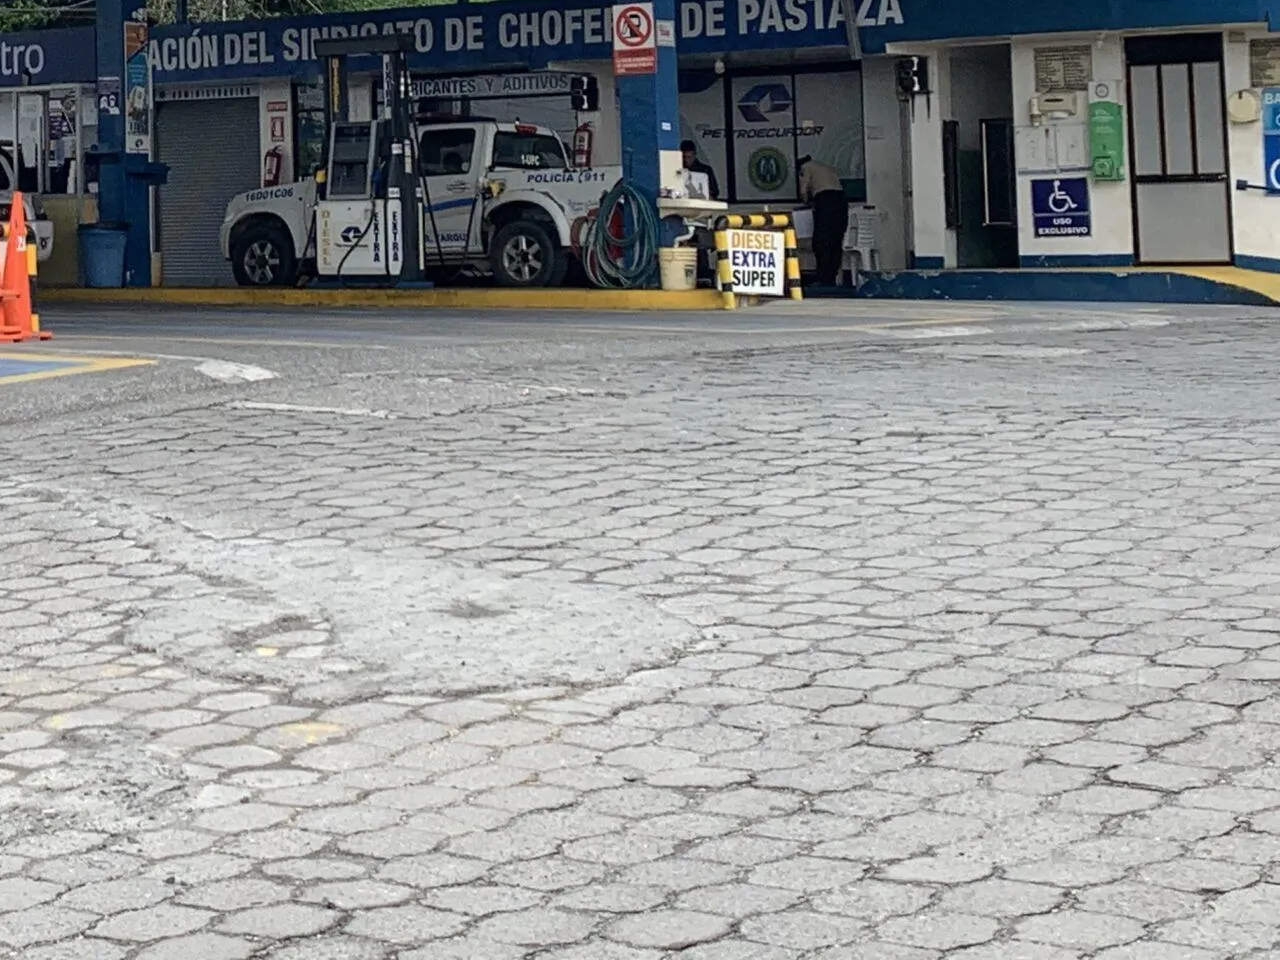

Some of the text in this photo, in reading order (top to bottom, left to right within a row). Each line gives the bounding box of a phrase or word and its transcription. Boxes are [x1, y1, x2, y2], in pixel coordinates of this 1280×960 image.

[224, 31, 275, 66] DEL
[444, 16, 485, 52] DE
[681, 0, 726, 38] DE
[485, 78, 494, 90] Y
[503, 74, 569, 91] ADITIVOS
[584, 172, 606, 182] 911
[1053, 217, 1073, 225] USO
[373, 212, 381, 262] EXTRA
[392, 211, 400, 262] EXTRA
[1038, 226, 1089, 235] EXCLUSIVO
[731, 231, 778, 250] DIESEL
[732, 250, 776, 268] EXTRA
[732, 269, 776, 288] SUPER
